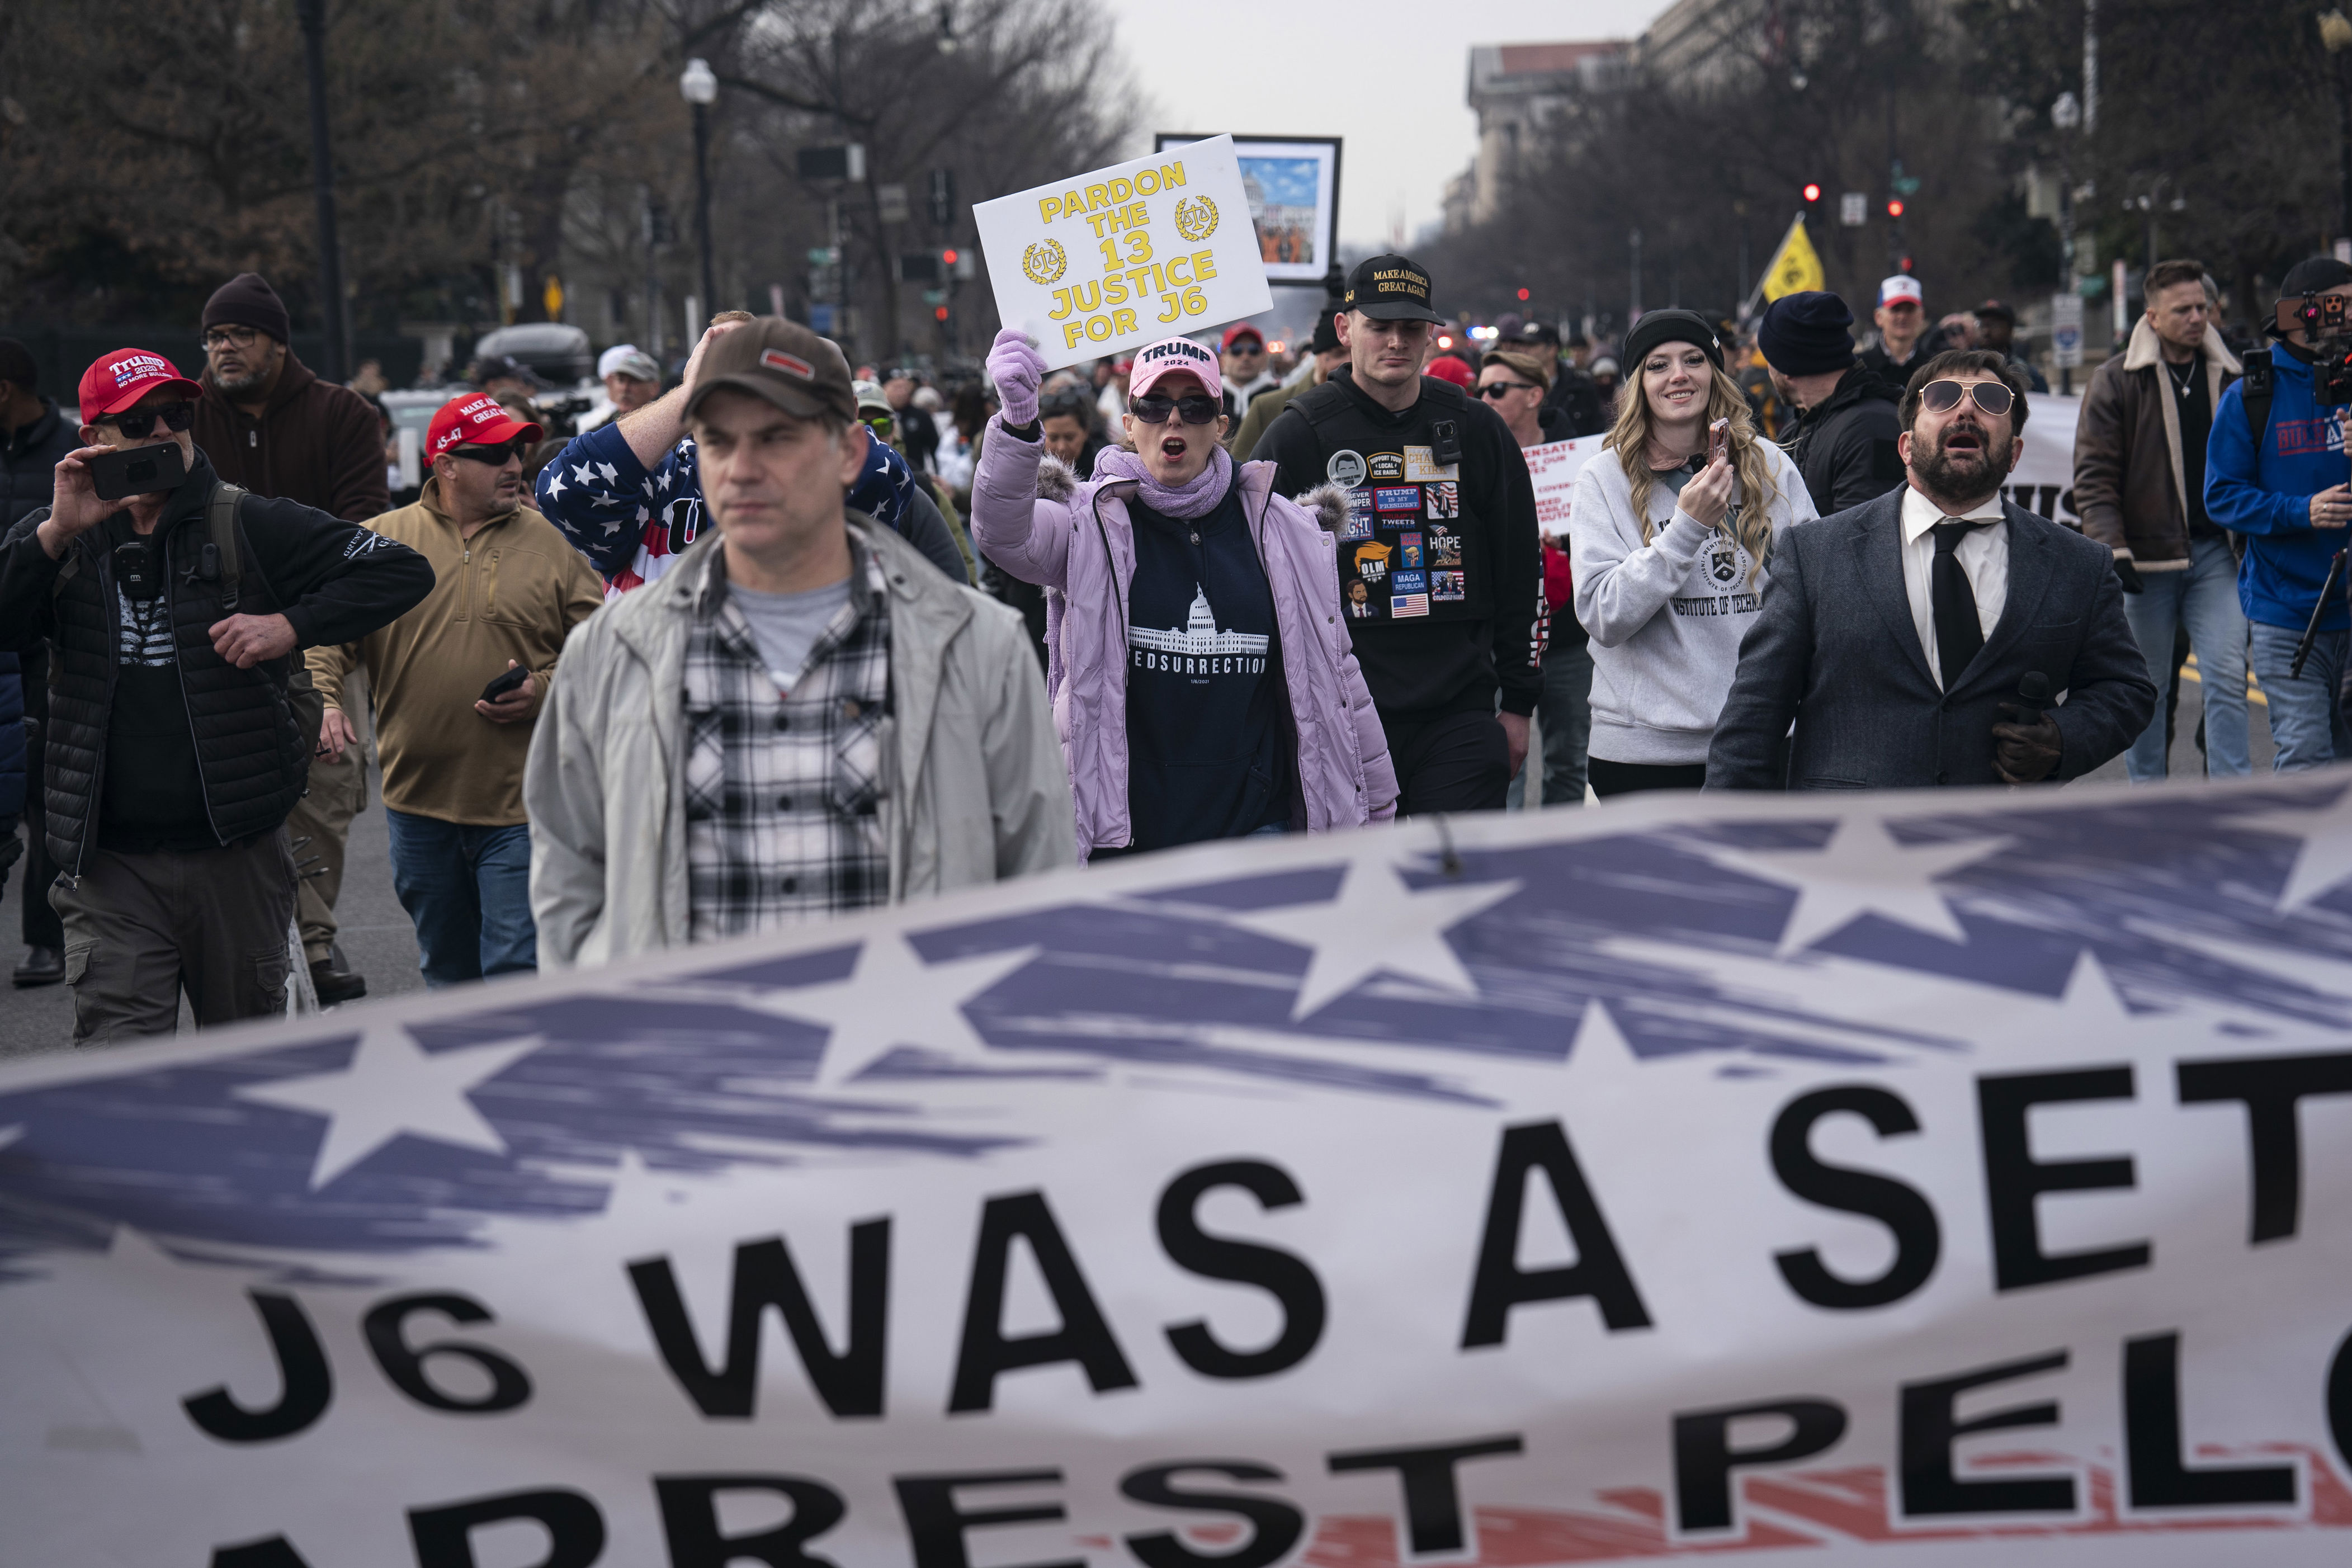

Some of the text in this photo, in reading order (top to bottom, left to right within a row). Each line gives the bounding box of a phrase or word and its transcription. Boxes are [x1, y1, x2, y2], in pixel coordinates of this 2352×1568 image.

[1039, 161, 1186, 224] PARDON
[1087, 201, 1150, 238] THE
[1099, 230, 1153, 272] 13
[1048, 249, 1217, 320] JUSTICE
[1373, 269, 1429, 288] MAKE AMERICA
[1378, 282, 1426, 299] GREAT AGAIN
[1062, 286, 1207, 349] FOR J6
[1142, 342, 1211, 363] TRUMP
[108, 355, 165, 376] Trump
[135, 365, 158, 374] 2020
[129, 374, 148, 382] MORE
[460, 399, 487, 415] MAKE
[473, 408, 500, 423] GREAT
[437, 427, 462, 449] 45-47
[1369, 455, 1402, 464] SUPPORT YOUR
[1523, 442, 1576, 458] ENSATE
[1419, 465, 1447, 475] KIRK
[1377, 488, 1416, 497] TRUMP
[343, 530, 363, 556] GRUNT
[1429, 536, 1461, 550] HOPE
[1361, 560, 1385, 574] OLM
[1701, 560, 1718, 591] INSTITUTE
[1395, 582, 1424, 591] REPUBLICAN
[1397, 574, 1420, 583] MAGA
[1719, 595, 1729, 615] OF
[1128, 649, 1266, 674] EDSURRECTION
[178, 1049, 2352, 1448] J6 WAS A SET
[1669, 1328, 2352, 1534] PEL
